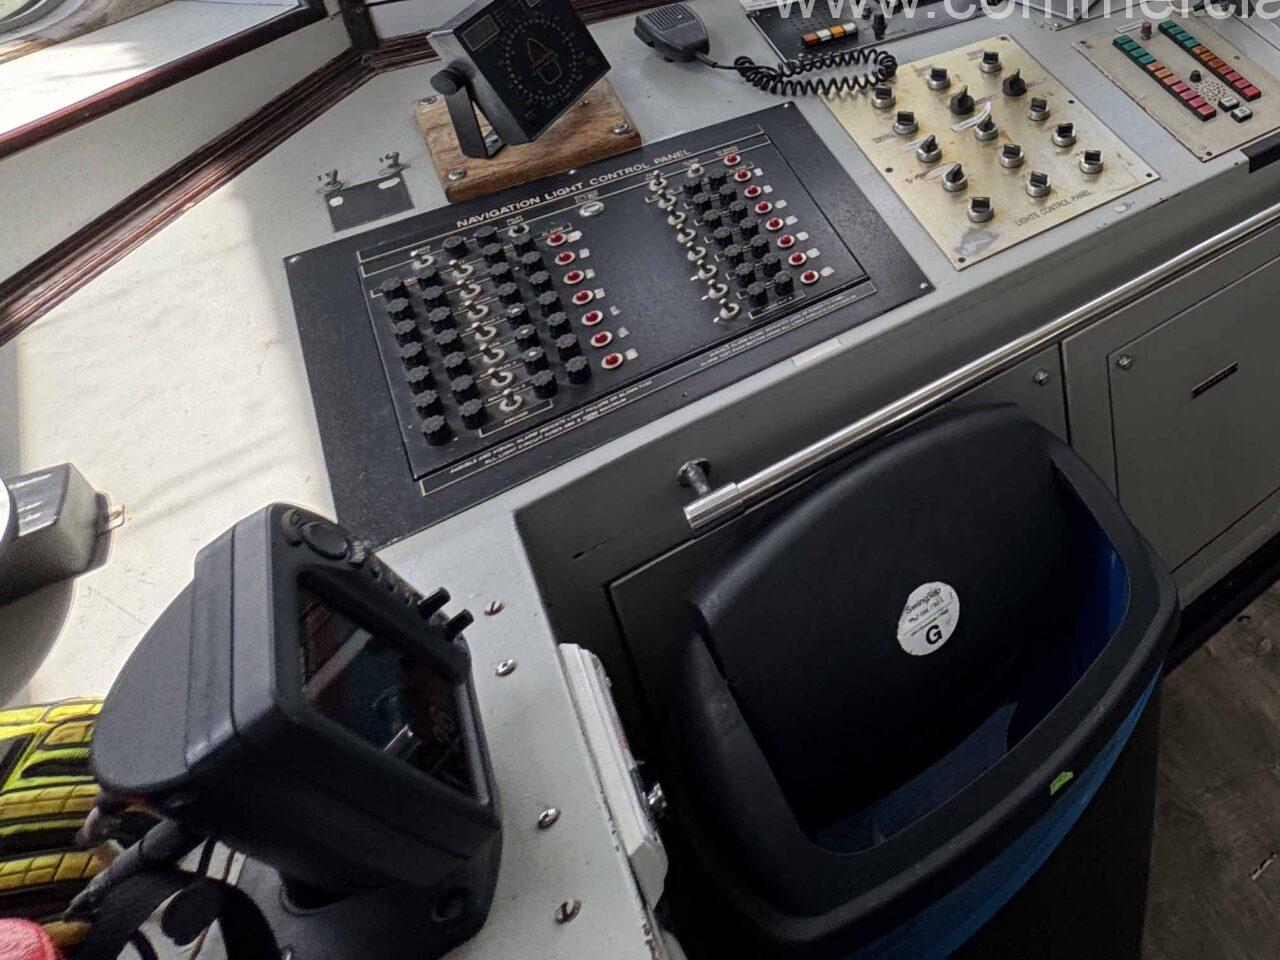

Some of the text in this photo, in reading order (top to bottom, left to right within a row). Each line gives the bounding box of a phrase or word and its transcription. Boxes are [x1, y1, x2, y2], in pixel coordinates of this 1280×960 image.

[456, 196, 541, 229] NAVIGATION
[545, 181, 584, 201] LIGHT
[589, 163, 650, 186] CONTROL
[653, 148, 692, 166] PANEL
[1014, 189, 1093, 228] LIGHTS CONTROL PANEL
[905, 587, 942, 615] SwingTop
[925, 624, 943, 645] G
